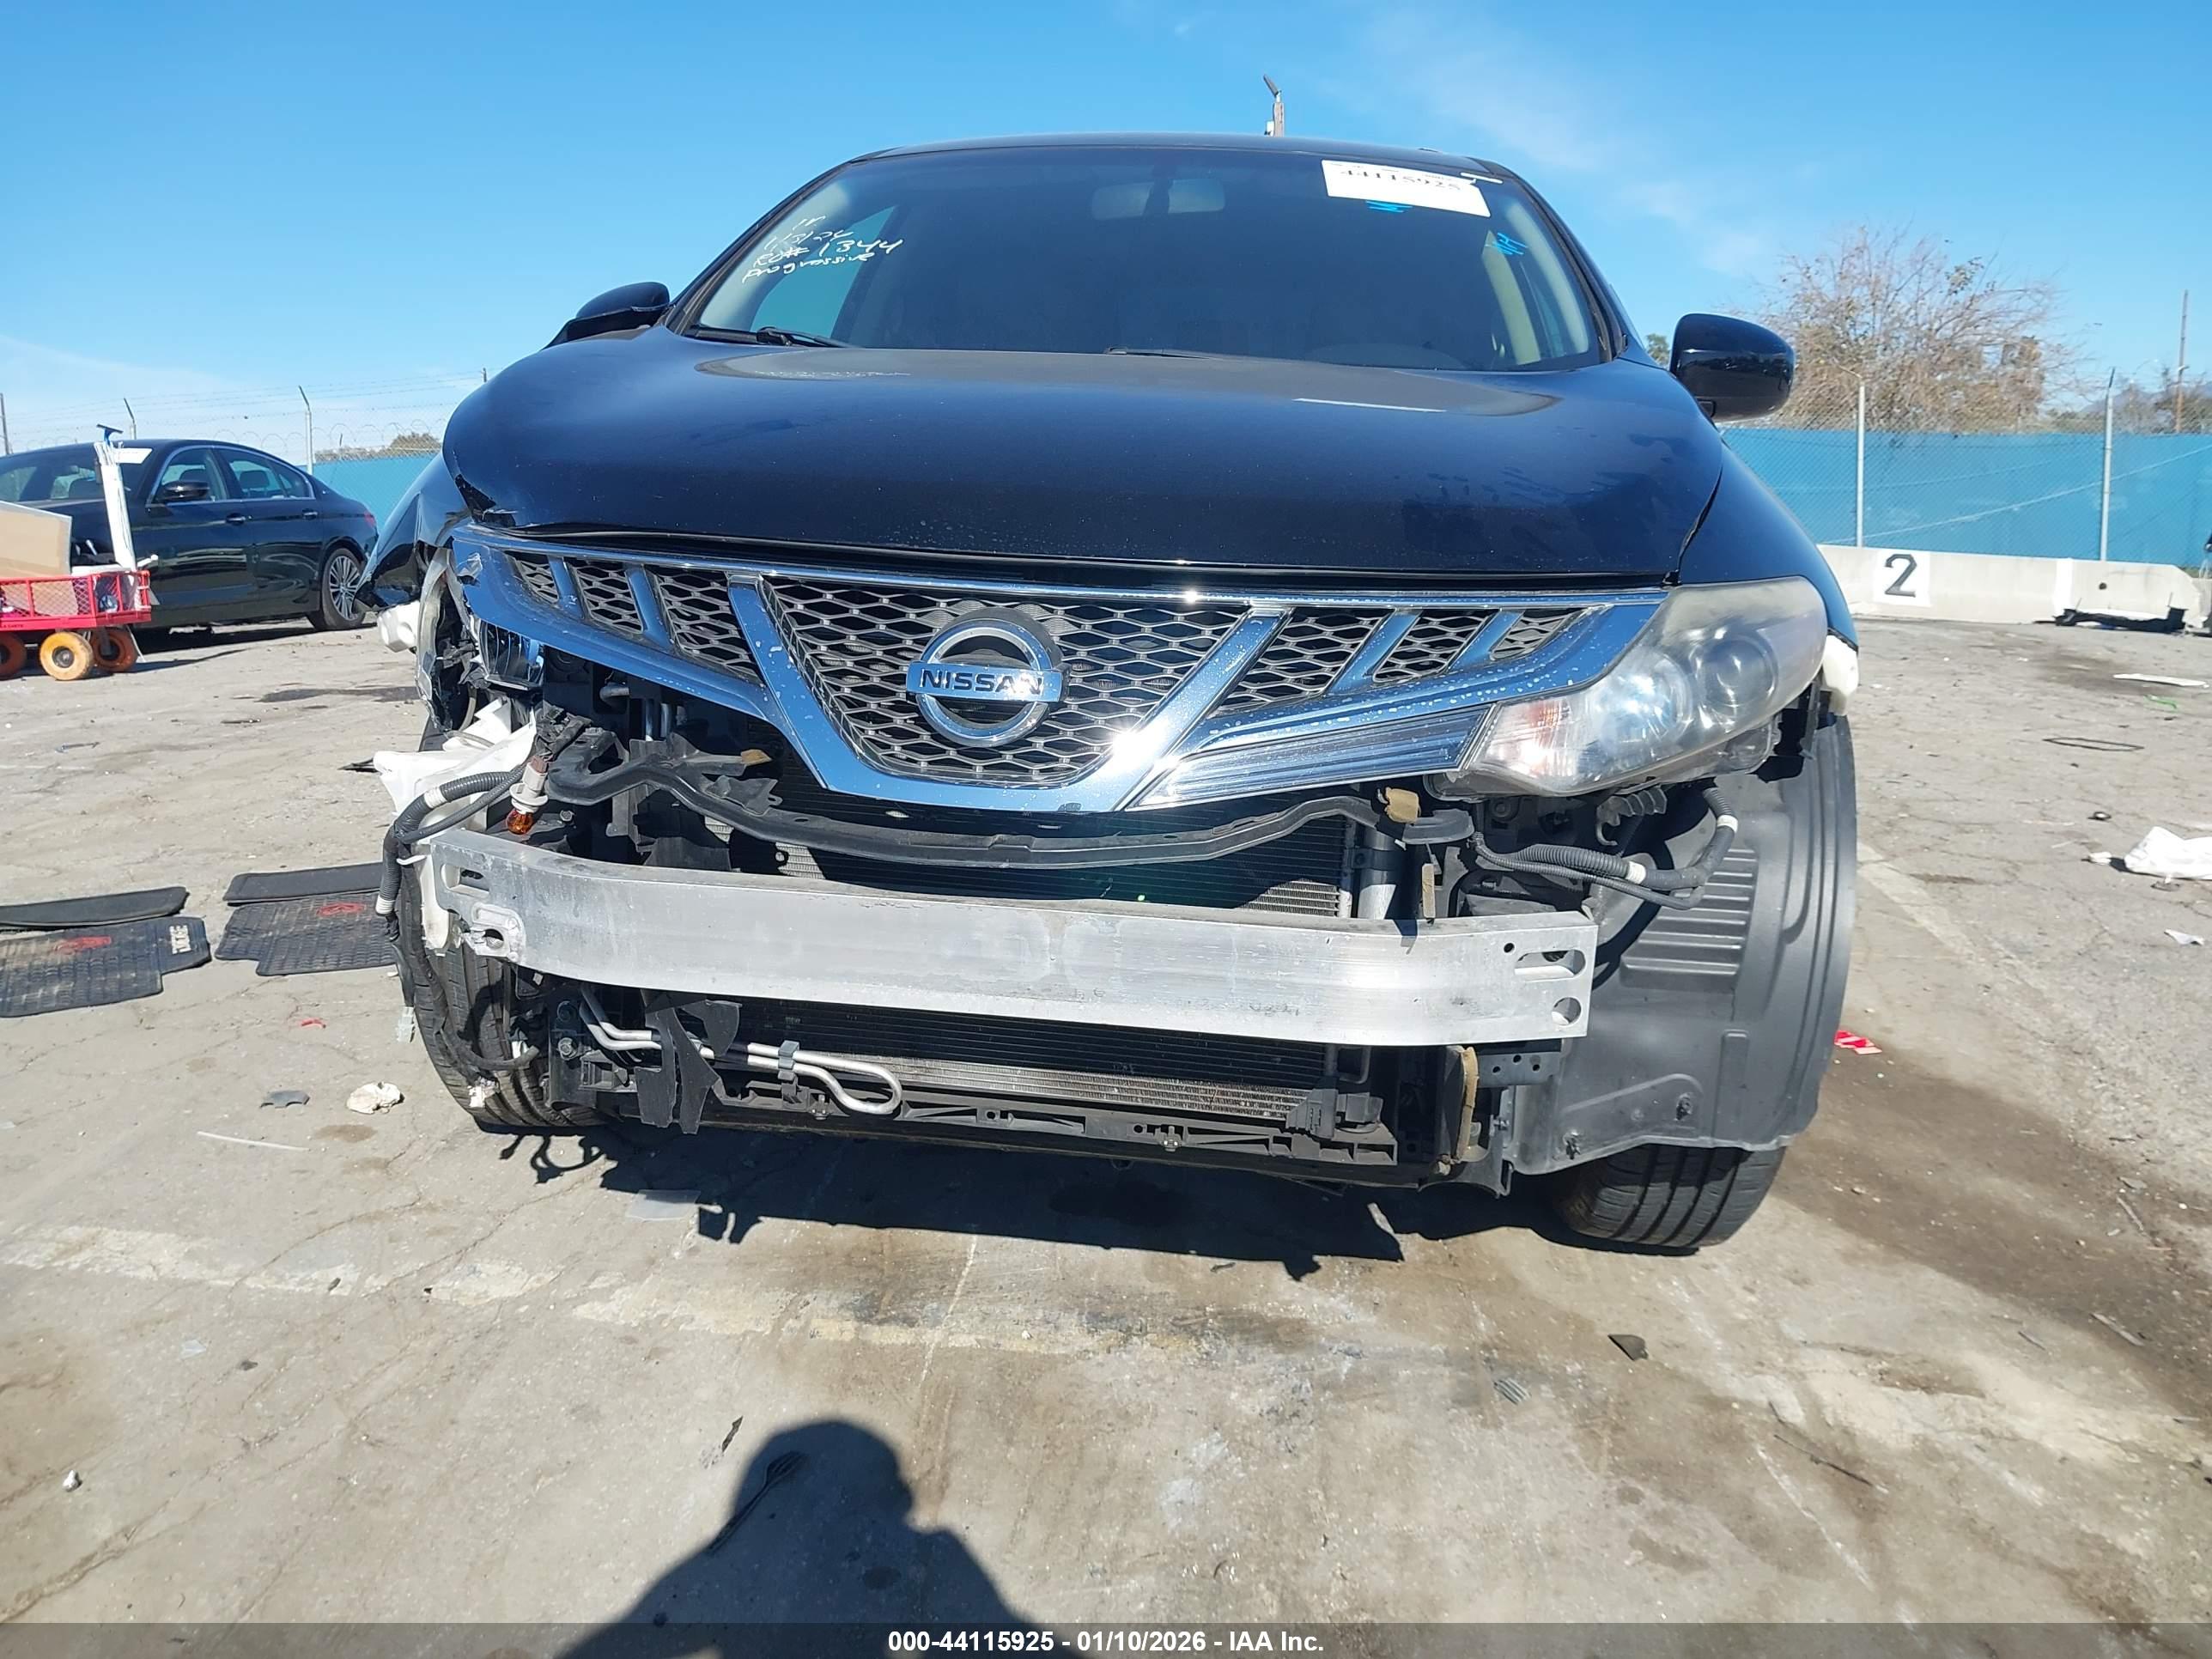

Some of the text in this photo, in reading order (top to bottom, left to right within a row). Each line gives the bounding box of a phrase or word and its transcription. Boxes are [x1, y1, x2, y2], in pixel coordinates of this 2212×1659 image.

[818, 238, 904, 258] 1344
[1884, 553, 1917, 598] 2
[919, 668, 1046, 696] NISSAN
